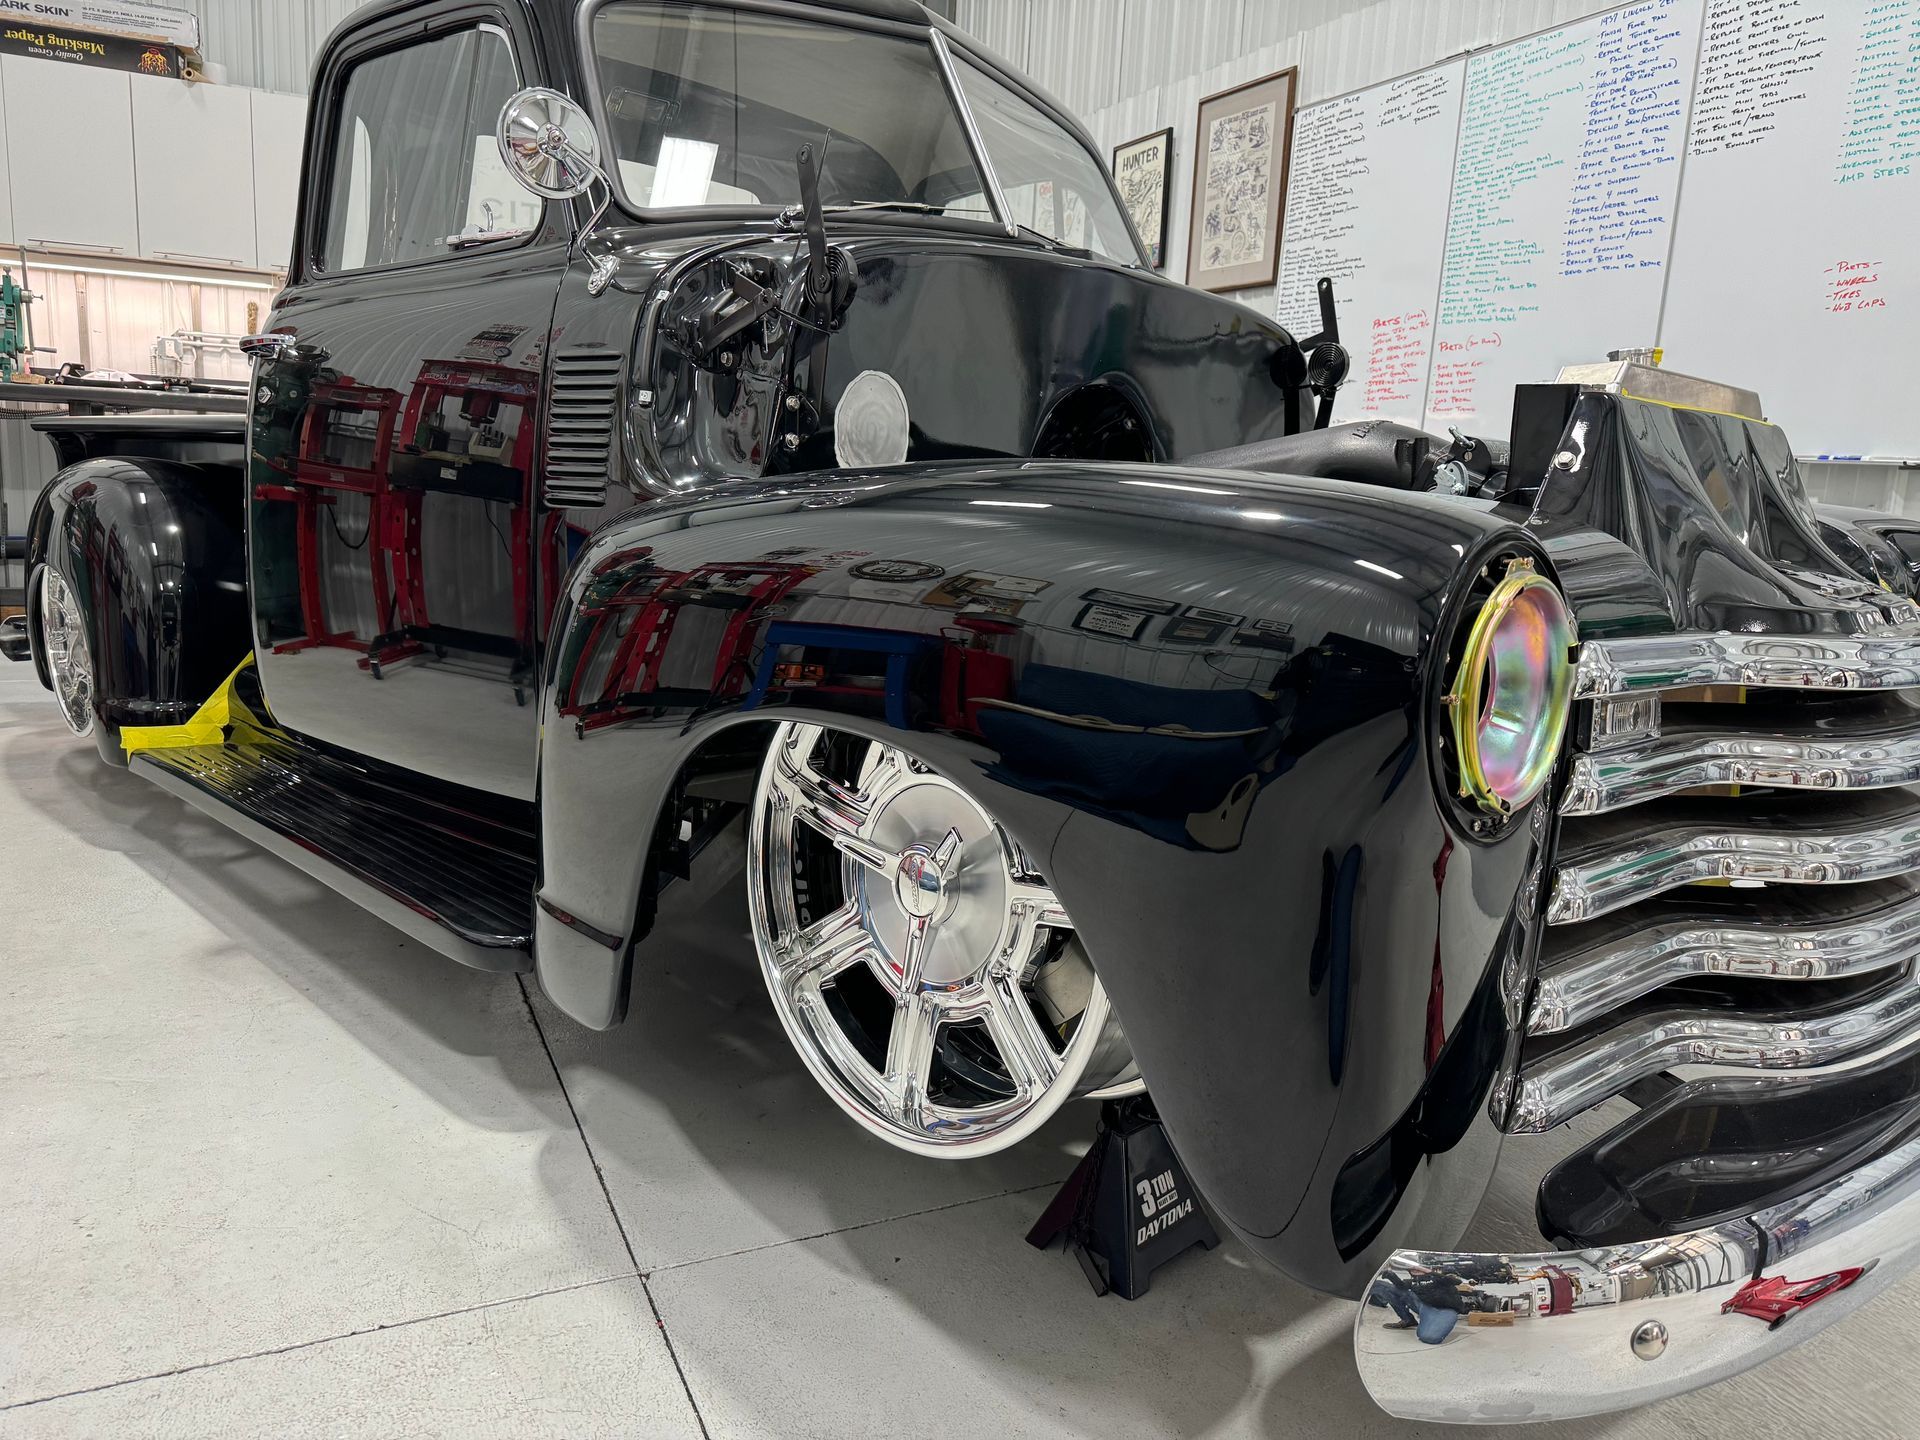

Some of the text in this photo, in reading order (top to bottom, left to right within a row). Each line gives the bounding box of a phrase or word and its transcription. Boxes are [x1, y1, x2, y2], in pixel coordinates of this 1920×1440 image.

[1711, 5, 1740, 19] REPLACE
[1871, 1, 1910, 14] INSTALL
[1600, 4, 1654, 26] 1937 LINCOLN
[1600, 28, 1621, 39] FINISH
[1652, 14, 1668, 22] PAN
[1711, 15, 1744, 30] REPLACE
[1600, 28, 1658, 48] FINISH TUNNEL
[1710, 38, 1742, 52] REPLACE
[1773, 24, 1790, 33] EDGE
[1806, 14, 1825, 24] DASH
[1711, 26, 1743, 42] REPLACE
[4, 29, 105, 55] Masking Paper
[1627, 39, 1650, 50] LOWER
[28, 46, 84, 61] Quality Green
[1642, 44, 1664, 54] RUST
[1708, 49, 1743, 63] REPLACE
[1737, 56, 1753, 65] NEW
[1861, 51, 1899, 63] INSTALL
[1860, 61, 1905, 74] INSTALL
[1705, 77, 1718, 85] FIT
[1595, 85, 1627, 100] FIT DOOR
[1703, 82, 1735, 95] REPLACE
[1855, 84, 1890, 94] INSTALL
[1699, 93, 1729, 106] INSTALL
[1736, 87, 1753, 96] NEW
[1854, 95, 1880, 104] WIRE
[1699, 104, 1726, 116] INSTALL
[1855, 104, 1891, 113] INSTALL
[1697, 115, 1724, 126] INSTALL
[1642, 124, 1670, 134] FENDER
[1694, 135, 1726, 146] MEASURE
[1748, 125, 1775, 134] WHEELS
[1695, 127, 1708, 136] FIT
[1693, 137, 1765, 156] BUILD EXHAUST
[1846, 137, 1884, 148] INSTALL
[1610, 153, 1637, 163] RUNNING
[1845, 147, 1880, 158] INSTALL
[1123, 146, 1159, 173] HUNTER
[1577, 162, 1651, 180] FIT WELD RUNNING
[1839, 165, 1910, 184] AMP STEPS
[1572, 195, 1597, 205] LOWER
[1634, 195, 1659, 205] WHEELS
[1599, 221, 1625, 230] MASTER
[1593, 245, 1625, 253] EXHAUST
[1837, 261, 1870, 273] PARTS
[1837, 274, 1878, 286] WHEELS
[1833, 288, 1861, 301] TIRES
[1832, 298, 1885, 312] HUB CAPS
[1136, 1169, 1175, 1218] 3 TON
[1137, 1199, 1192, 1246] DAYTONA
